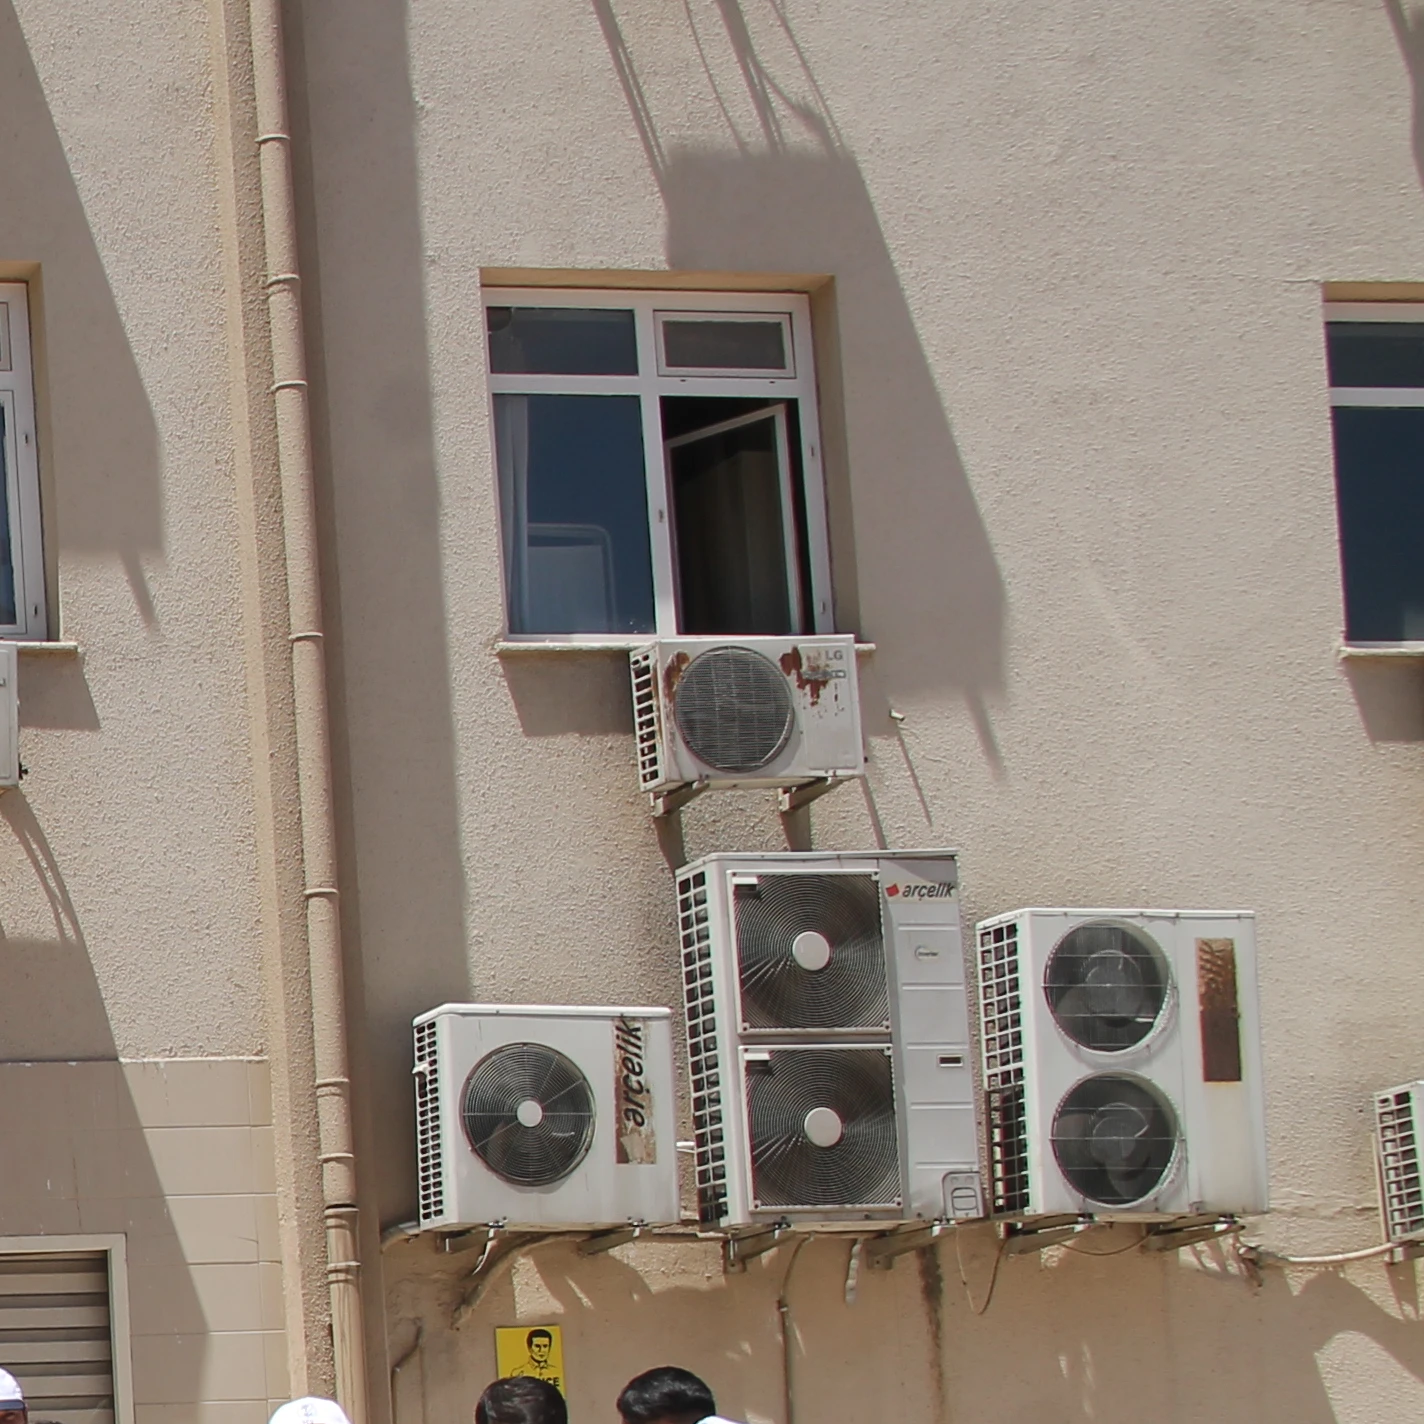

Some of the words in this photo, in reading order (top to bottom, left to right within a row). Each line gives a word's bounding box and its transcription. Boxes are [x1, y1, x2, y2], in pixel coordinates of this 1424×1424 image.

[825, 649, 844, 661] LG
[902, 882, 956, 901] arçelik
[615, 1013, 651, 1128] arçelik
